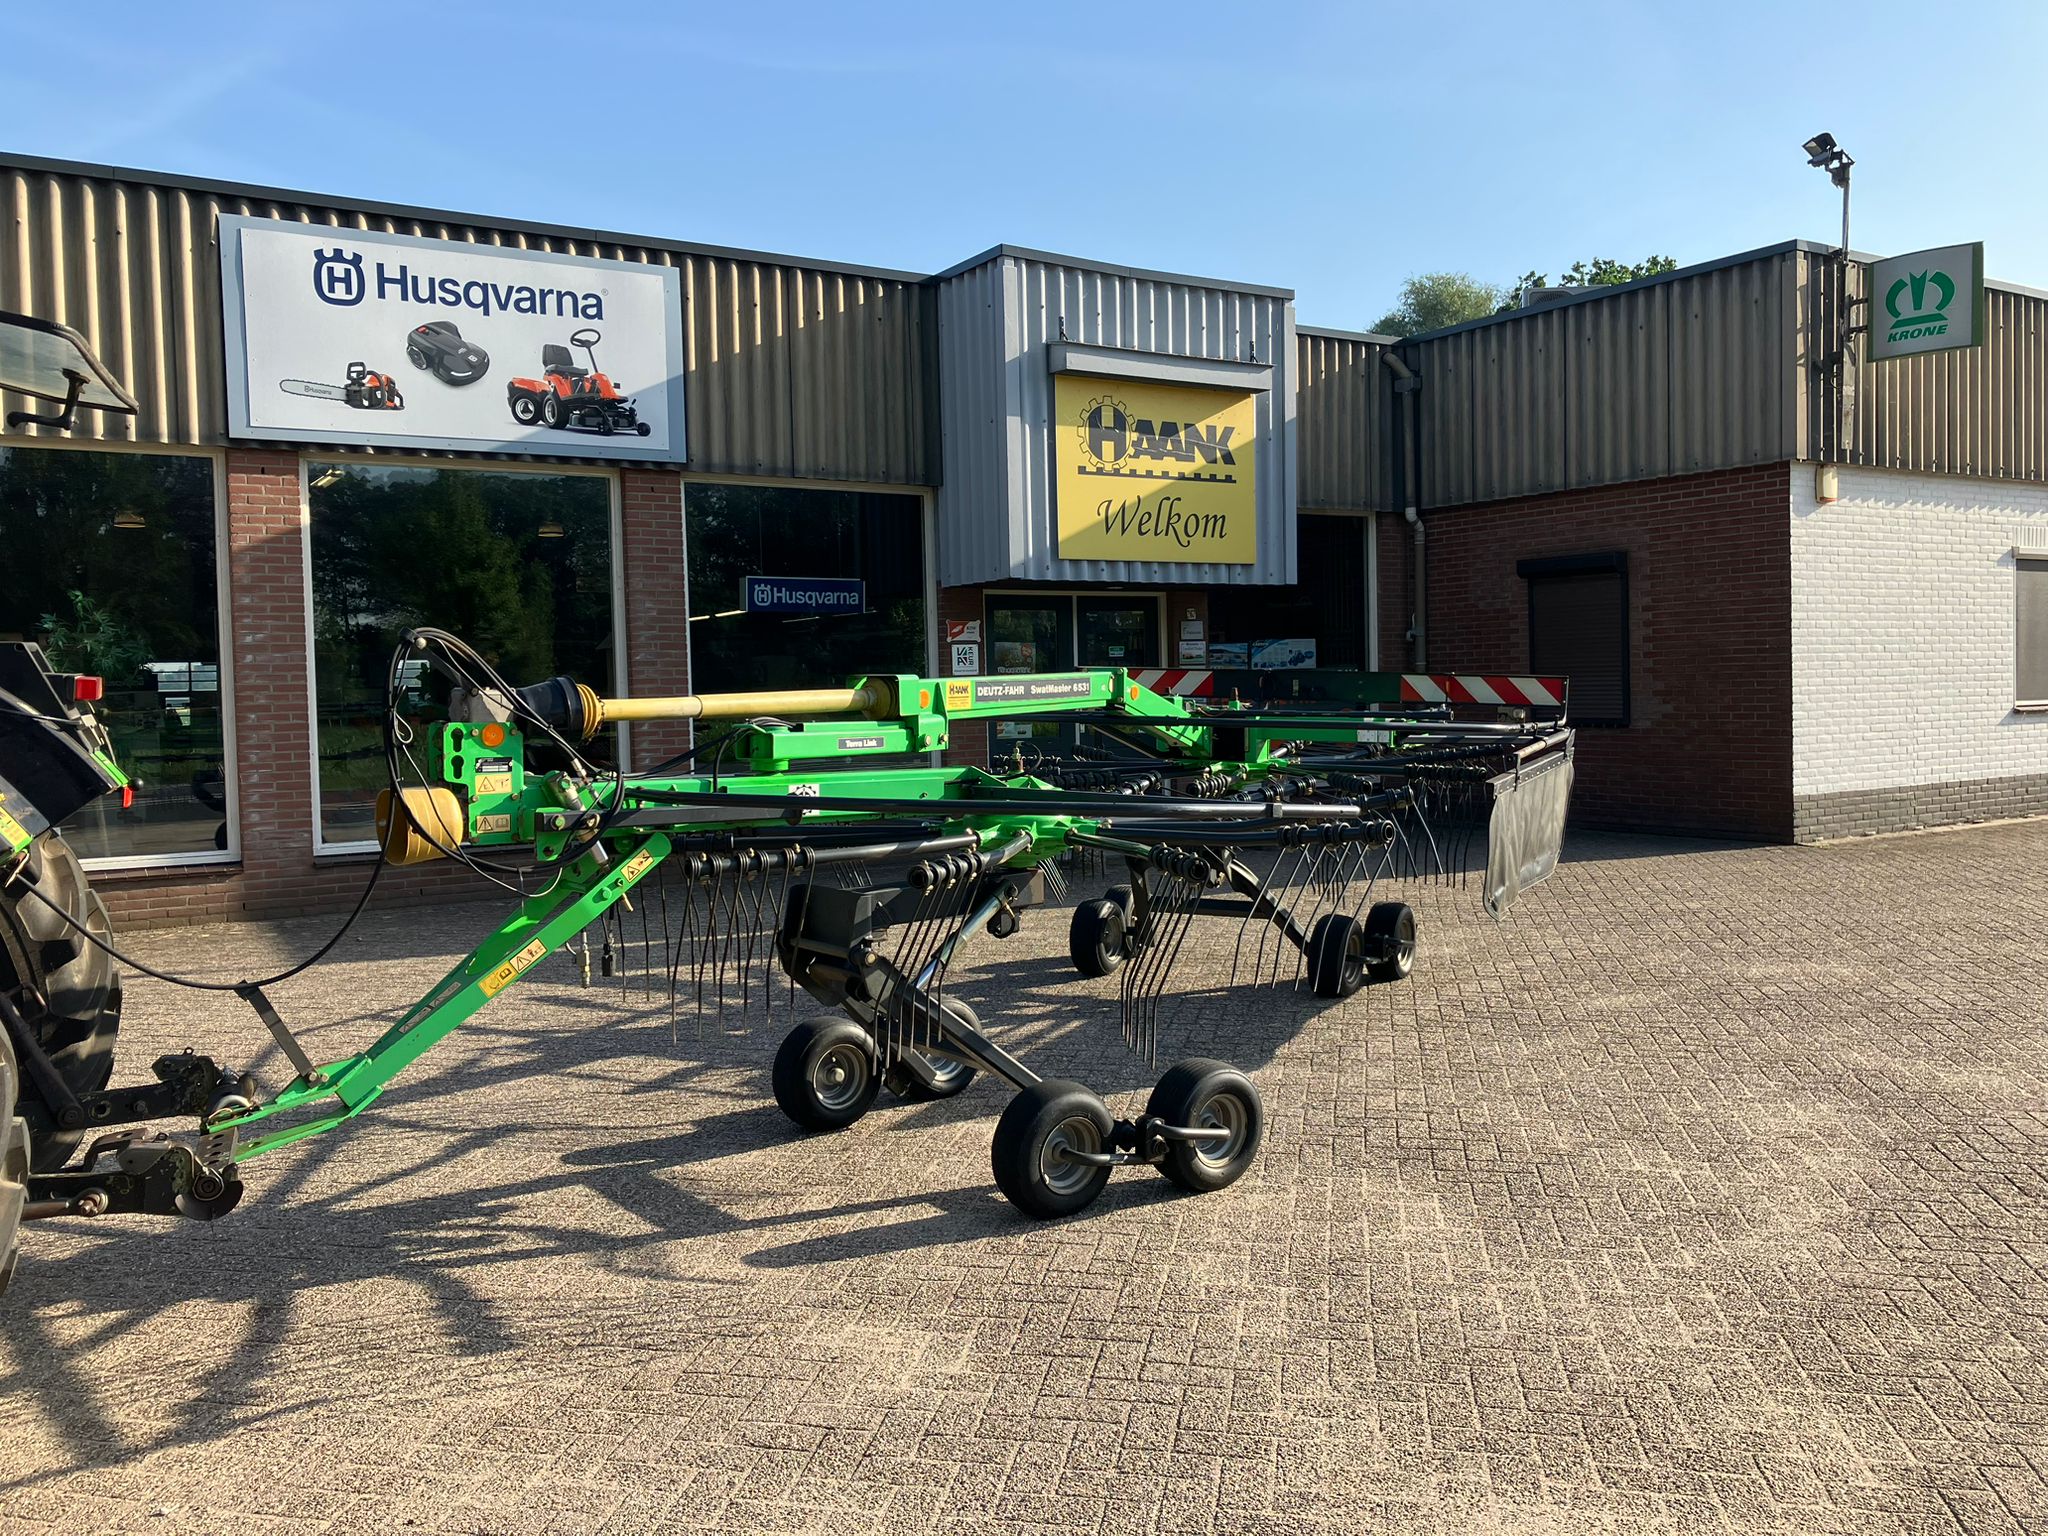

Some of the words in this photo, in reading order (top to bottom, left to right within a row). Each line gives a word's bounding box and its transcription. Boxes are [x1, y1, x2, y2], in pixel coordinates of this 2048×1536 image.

[376, 262, 604, 321] Husqvarna
[1887, 324, 1948, 343] KRONE
[1088, 404, 1236, 465] HAANK
[1097, 495, 1227, 548] Welkom
[773, 587, 859, 607] Husqvarna
[977, 685, 1025, 697] DEUTZ-FAHR
[1030, 683, 1072, 695] SwatMaster
